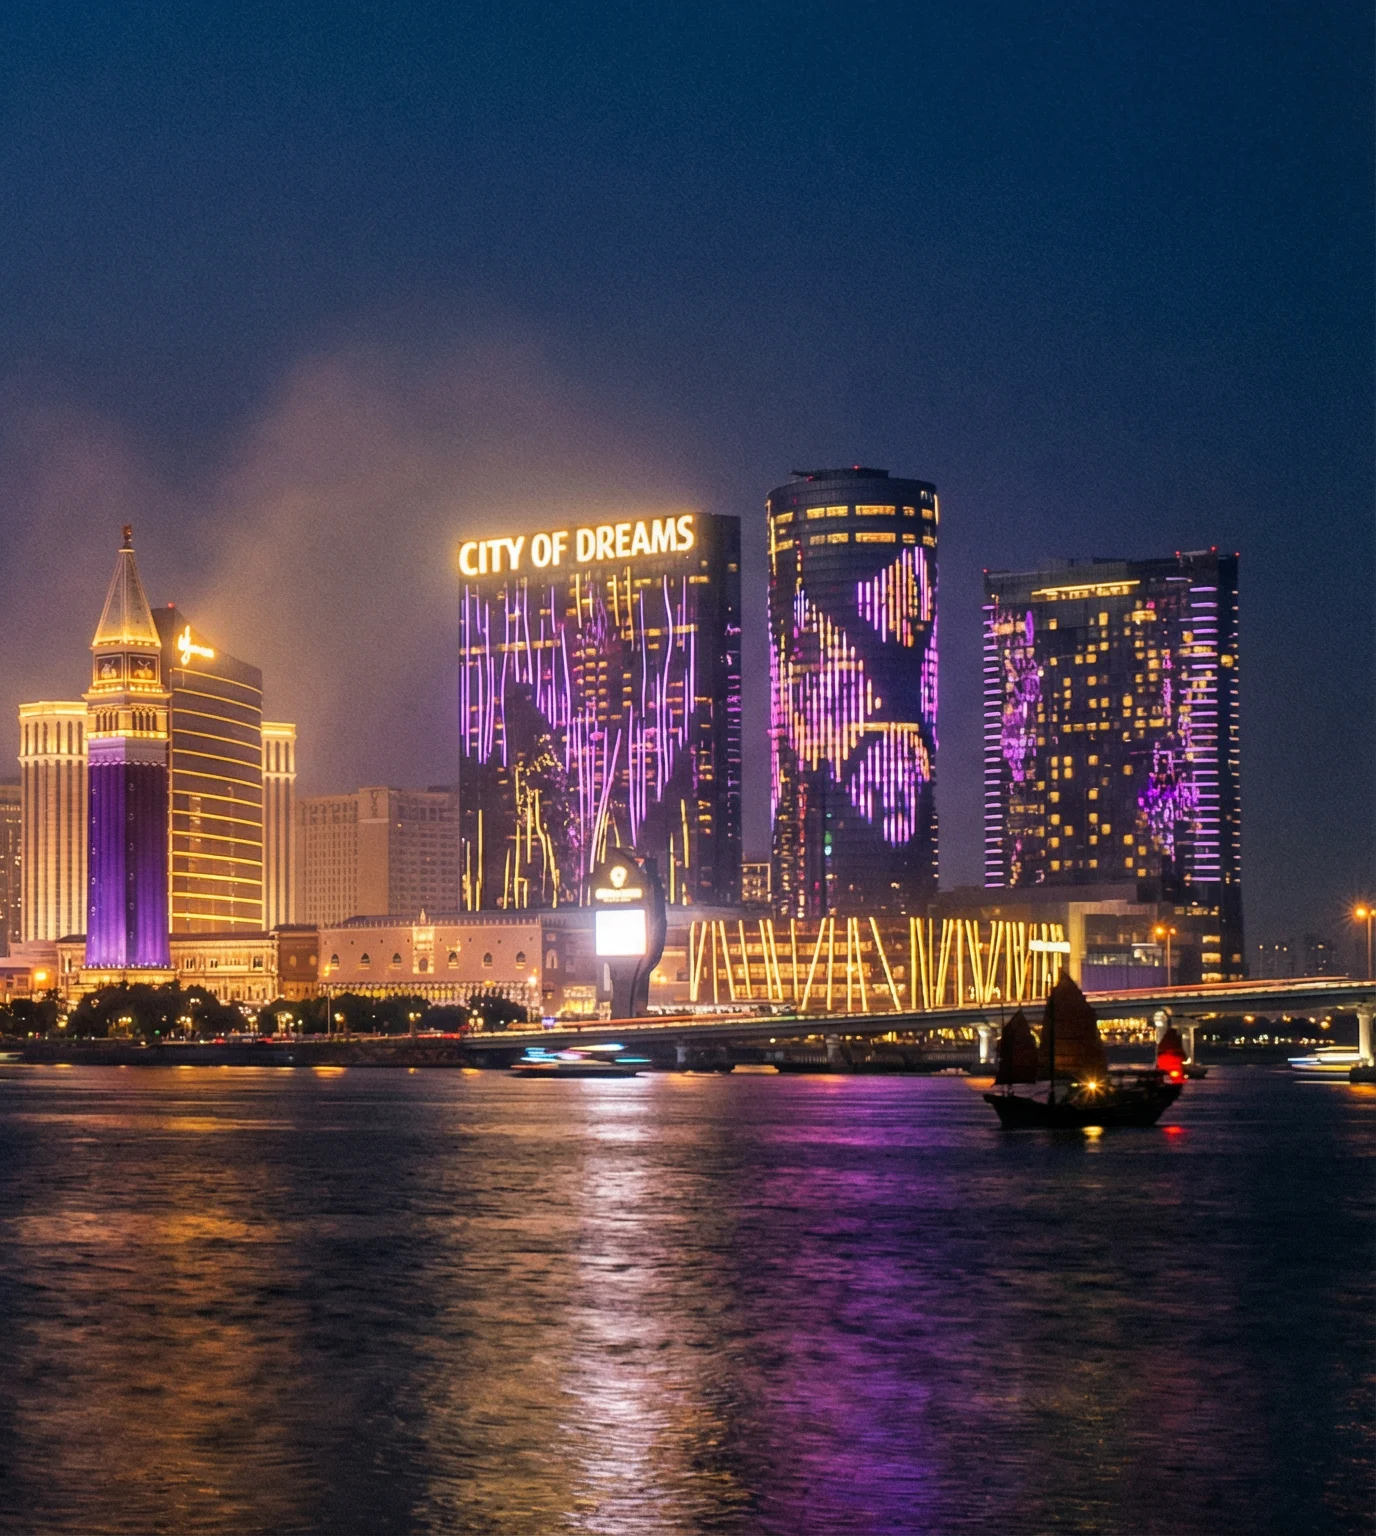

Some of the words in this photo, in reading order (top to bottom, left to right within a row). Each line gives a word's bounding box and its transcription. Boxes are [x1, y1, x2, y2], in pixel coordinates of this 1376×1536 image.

[458, 535, 526, 577] CITY
[531, 530, 569, 568] OF
[576, 514, 694, 563] DREAMS
